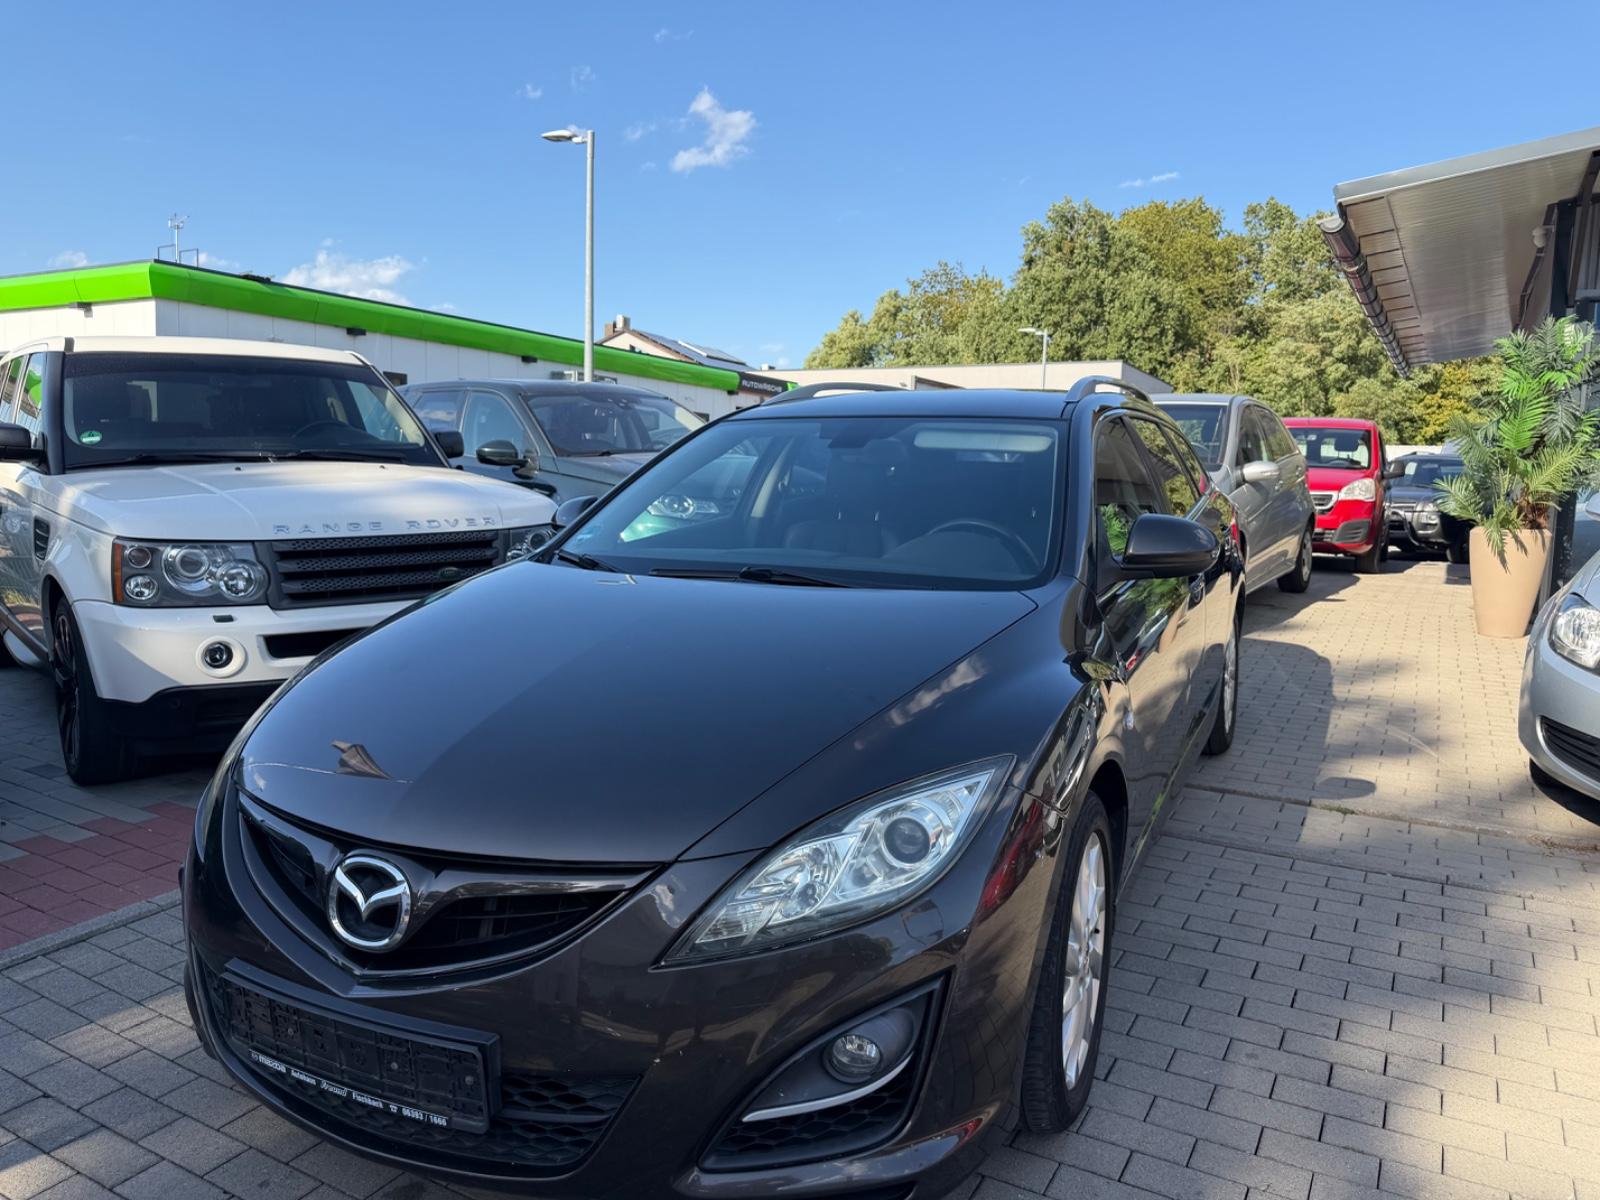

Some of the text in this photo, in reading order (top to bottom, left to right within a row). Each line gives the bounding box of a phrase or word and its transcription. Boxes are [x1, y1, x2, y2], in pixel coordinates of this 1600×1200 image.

[273, 517, 497, 535] RANGE ROVER
[259, 1054, 287, 1073] mazda
